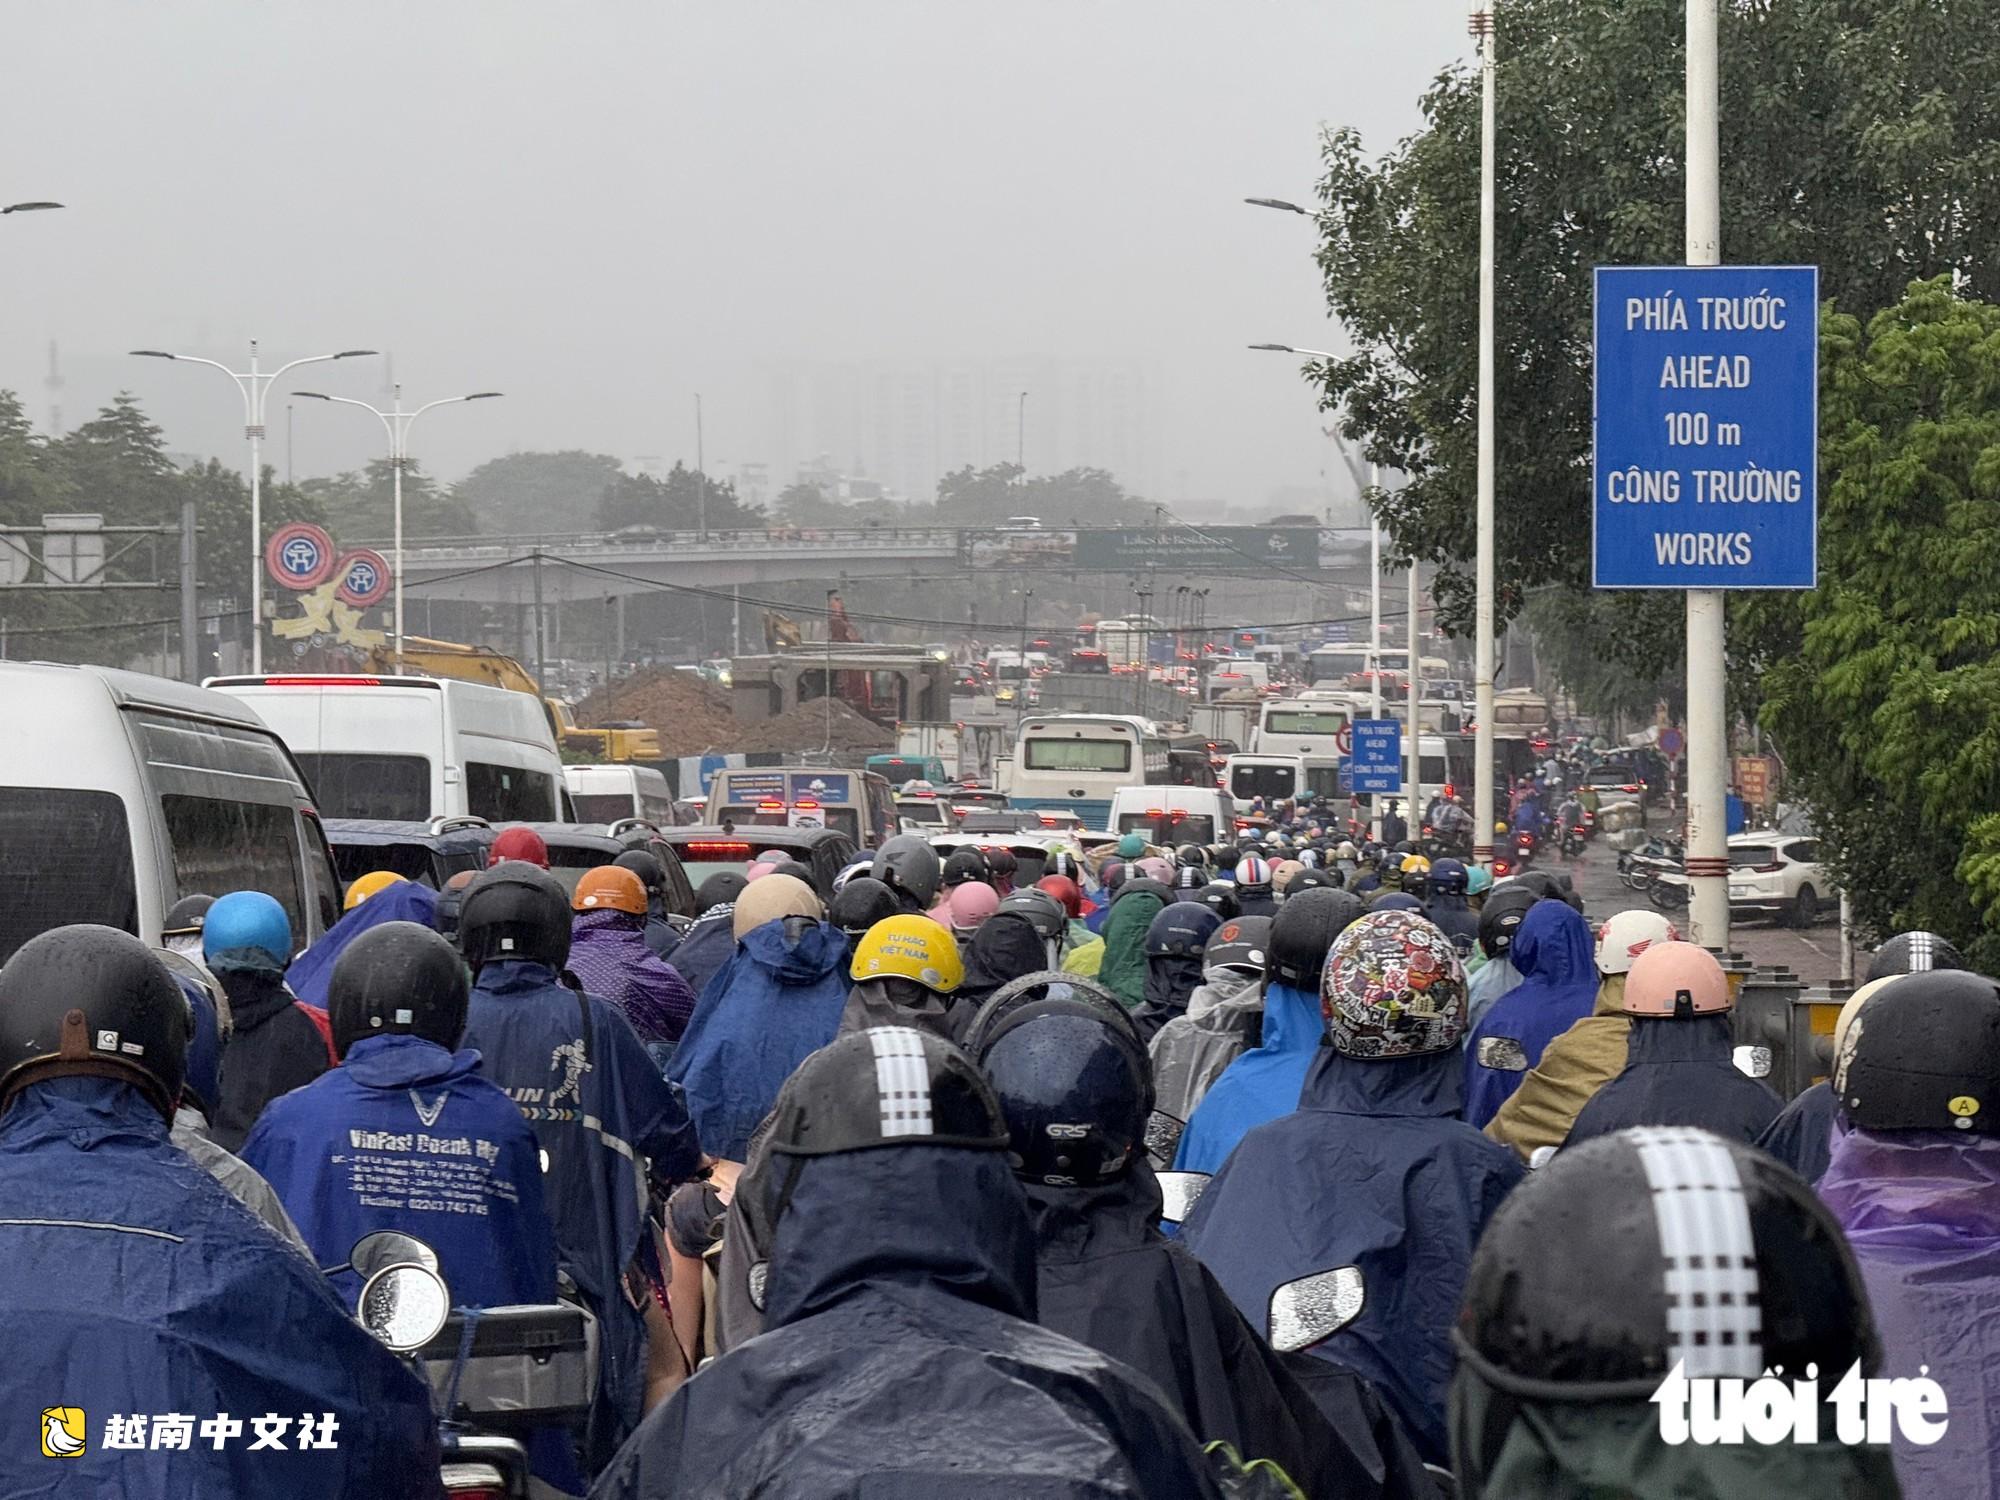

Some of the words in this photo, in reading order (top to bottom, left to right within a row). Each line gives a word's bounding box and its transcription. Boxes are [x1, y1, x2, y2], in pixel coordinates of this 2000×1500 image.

[1626, 290, 1688, 330] PHÍA
[1698, 289, 1786, 330] TRƯỚC
[1660, 356, 1750, 388] AHEAD
[1665, 413, 1709, 445] 100
[1717, 422, 1741, 445] m
[1608, 465, 1680, 503] CÔNG
[1692, 461, 1801, 503] TRƯỜNG
[1654, 533, 1752, 565] WORKS
